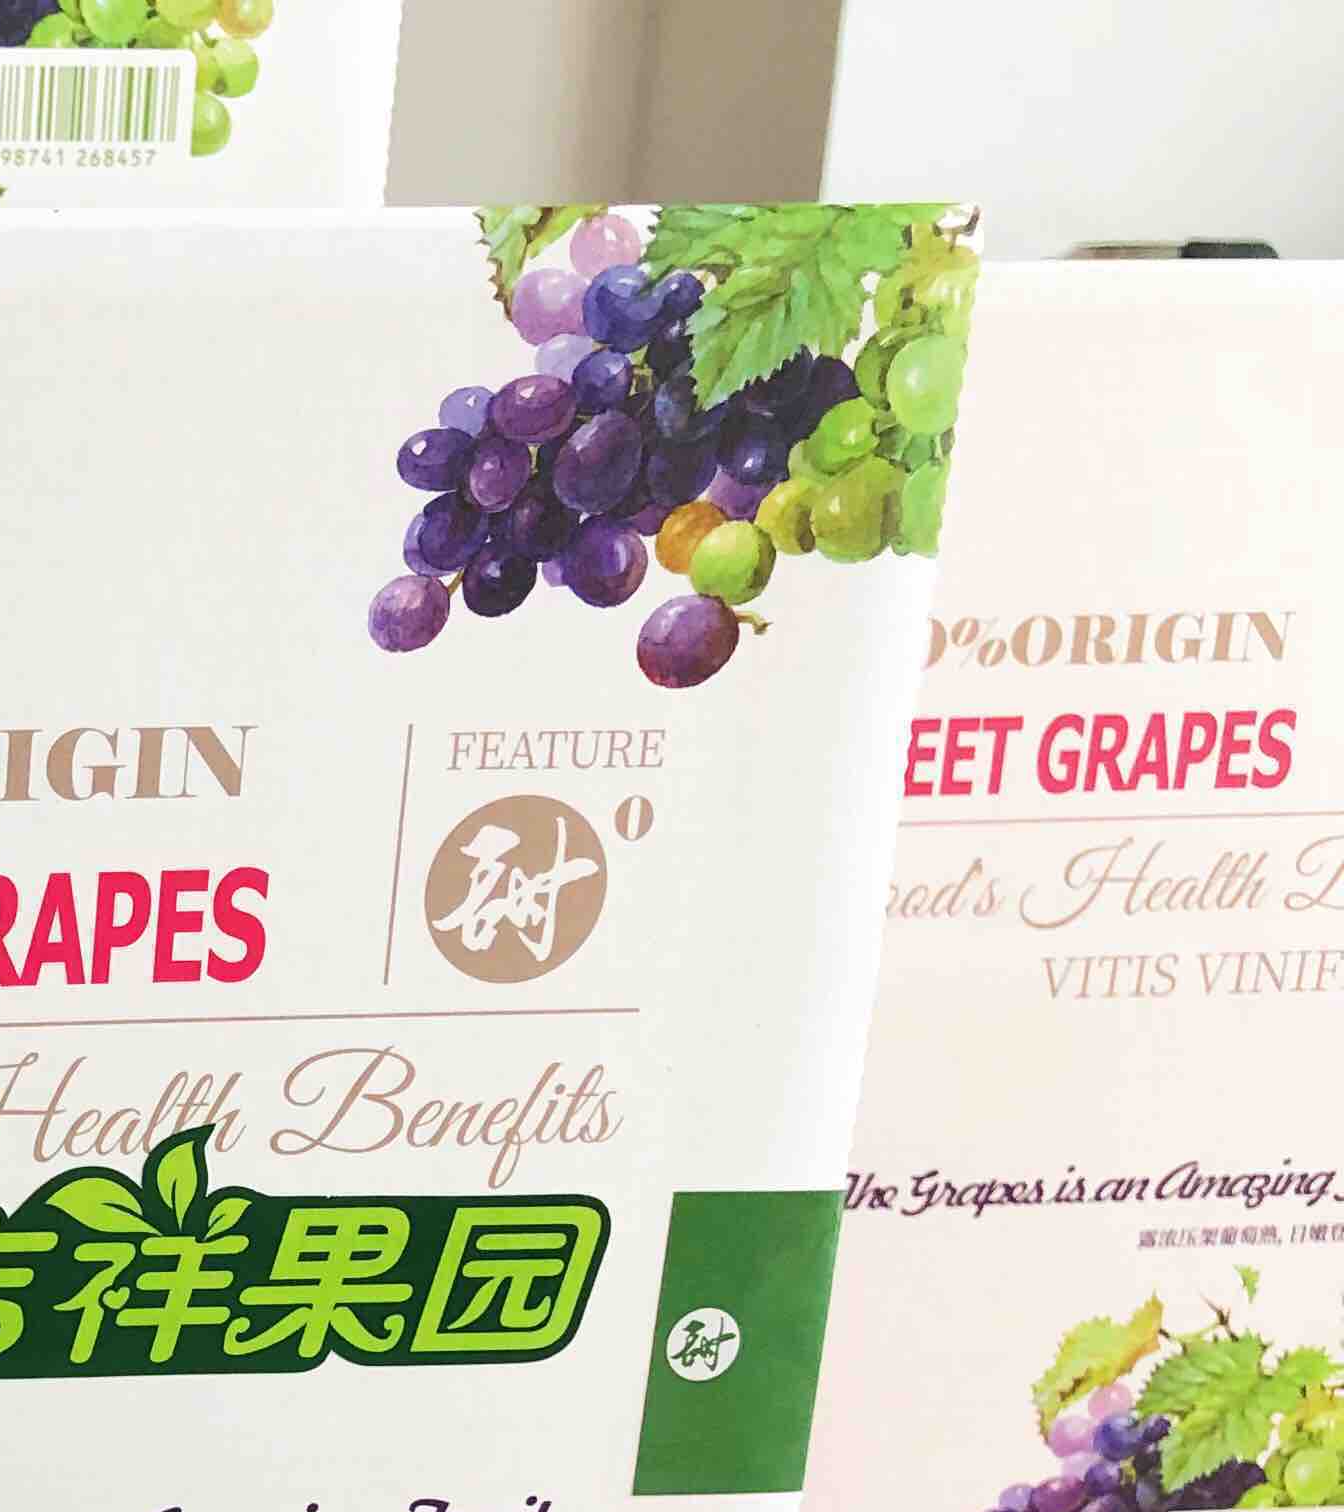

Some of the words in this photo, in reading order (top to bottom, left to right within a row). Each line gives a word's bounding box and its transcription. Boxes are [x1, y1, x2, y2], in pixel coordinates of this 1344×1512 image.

[76, 148, 158, 167] 268457
[448, 729, 666, 771] FEATURE
[904, 715, 1023, 797] EET
[1036, 709, 1297, 795] GRAPES
[1019, 836, 1269, 930] Health
[1042, 953, 1179, 1000] VITIS
[1196, 950, 1344, 996] VINIF
[269, 1045, 622, 1190] Benefits
[901, 1169, 1044, 1218] Grapes
[1051, 1165, 1087, 1204] is
[1094, 1175, 1150, 1202] an
[1155, 1157, 1336, 1208] Amazing
